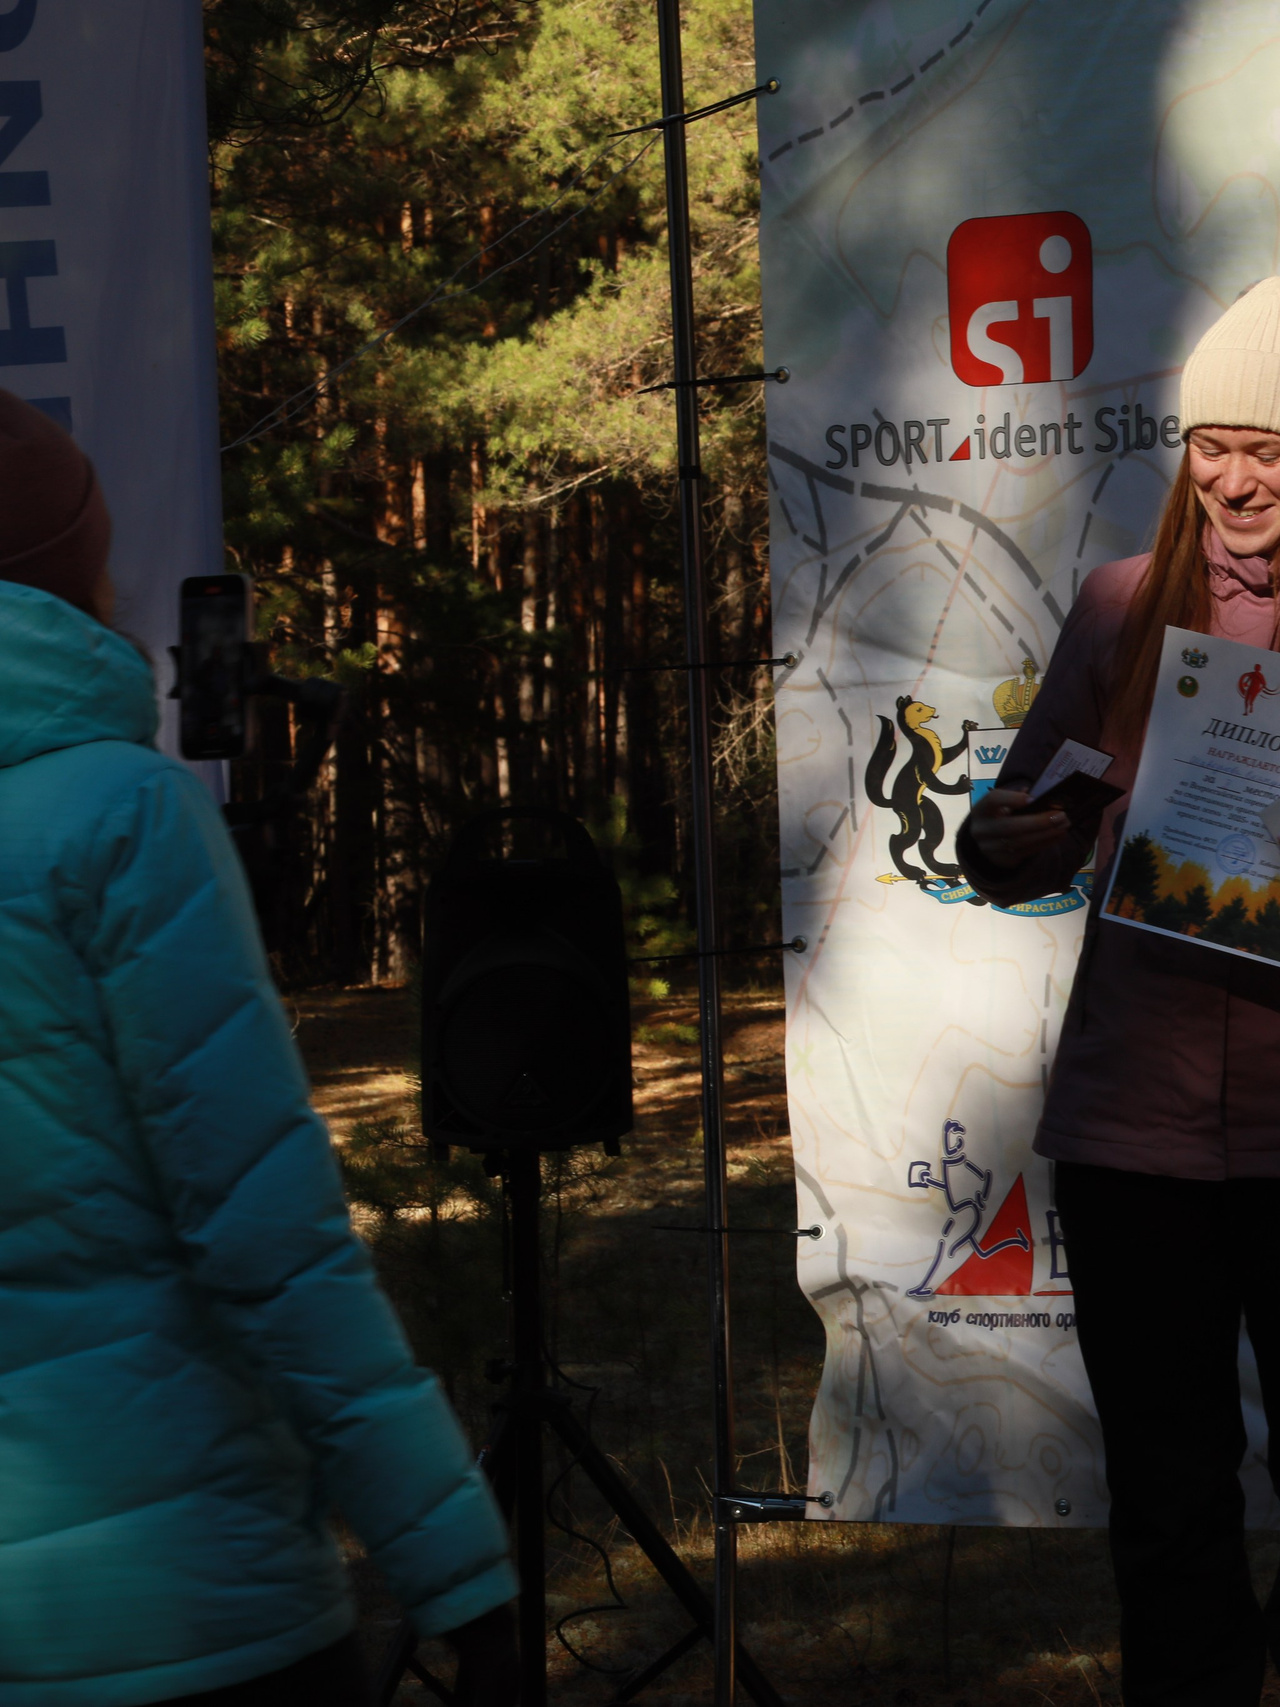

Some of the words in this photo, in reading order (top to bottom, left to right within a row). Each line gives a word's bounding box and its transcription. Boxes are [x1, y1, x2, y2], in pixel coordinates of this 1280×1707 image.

[966, 235, 1074, 384] si
[825, 417, 951, 470] SPORT
[972, 411, 1085, 460] ident
[927, 1307, 962, 1326] клуб
[965, 1310, 1051, 1331] спортивного
